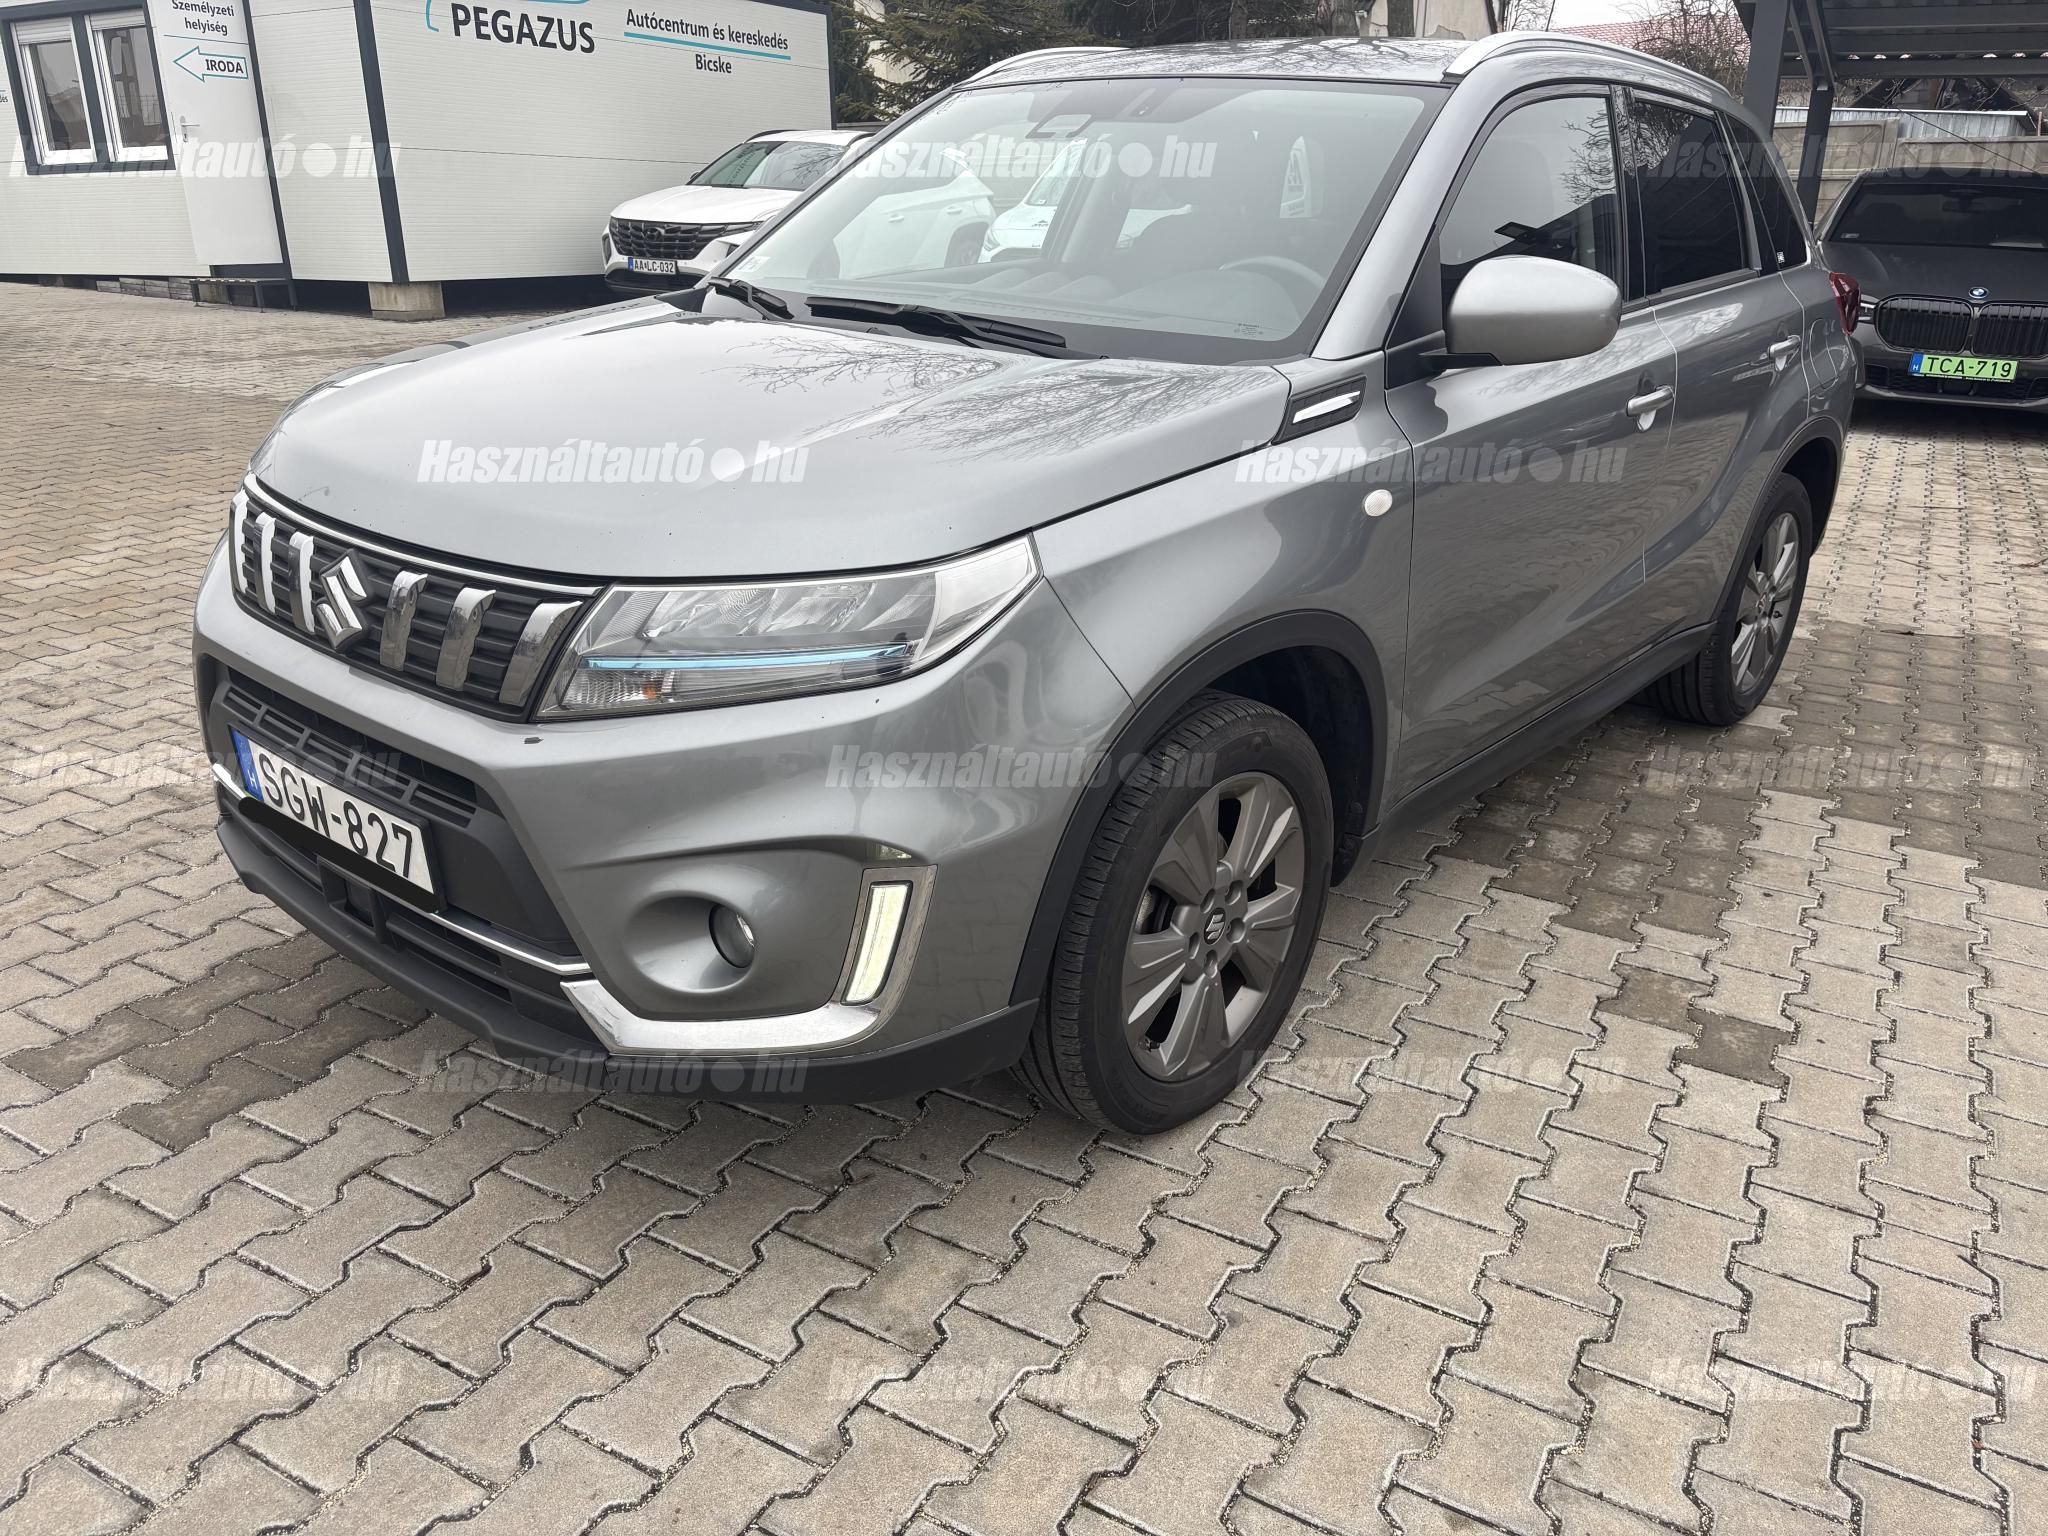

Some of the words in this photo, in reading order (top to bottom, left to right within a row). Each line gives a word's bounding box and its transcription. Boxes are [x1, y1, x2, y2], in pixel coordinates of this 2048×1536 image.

[172, 0, 235, 17] Személyzeti
[184, 17, 228, 36] helyiség
[451, 3, 595, 54] PEGAZUS
[626, 9, 709, 38] Autócentrum
[713, 23, 725, 41] és
[728, 25, 788, 50] kereskedés
[205, 59, 244, 74] IRODA
[695, 54, 732, 74] Bicske
[1927, 356, 2012, 378] TCA-719
[249, 770, 259, 788] H
[258, 752, 412, 878] SGW-827
